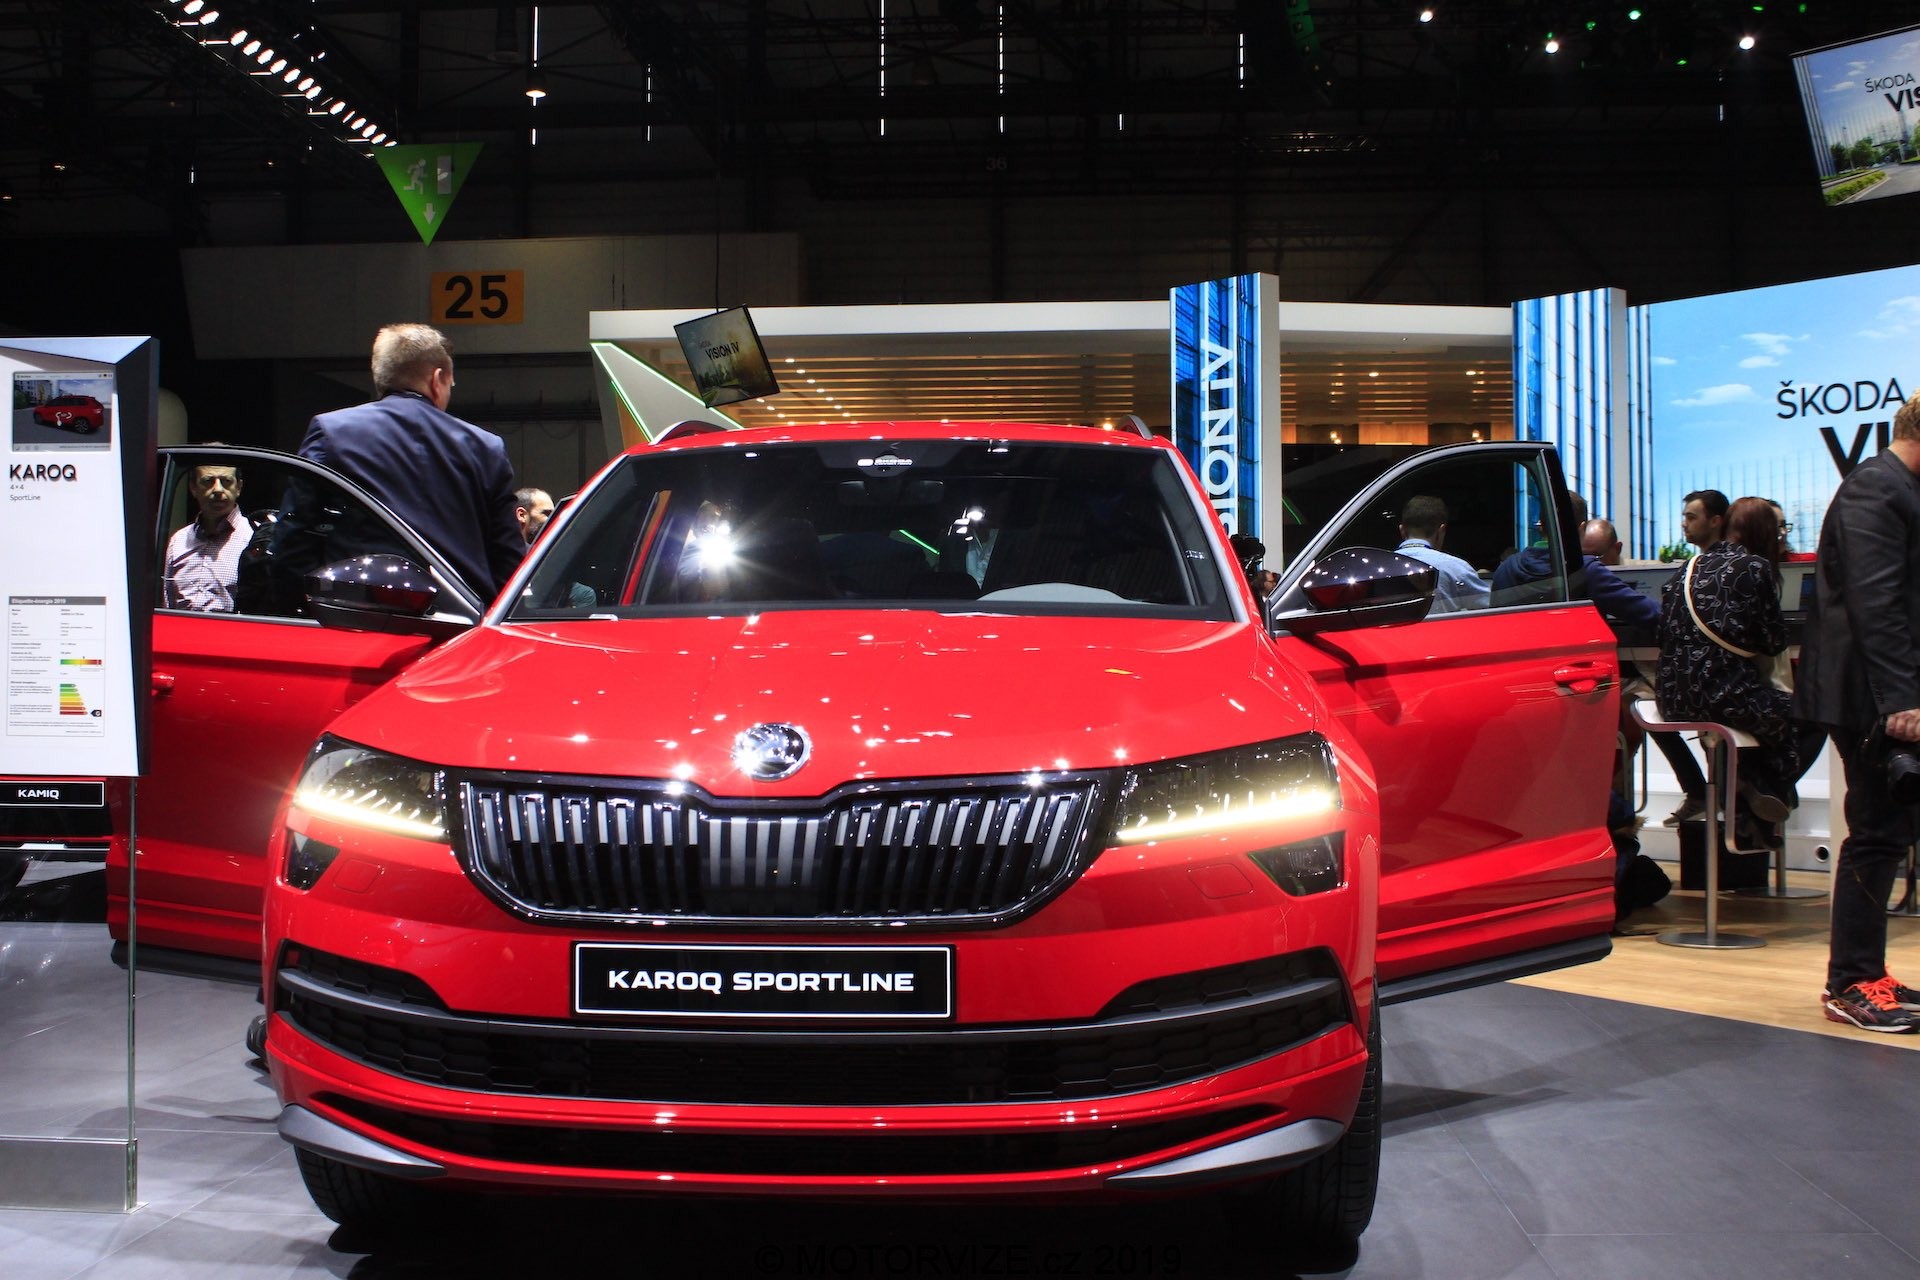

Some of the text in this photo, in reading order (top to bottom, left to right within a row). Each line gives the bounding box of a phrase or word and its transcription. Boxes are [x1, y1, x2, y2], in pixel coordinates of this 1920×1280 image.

[1865, 73, 1916, 93] ŠKODA
[1884, 87, 1920, 112] VIS
[445, 275, 509, 319] 25
[705, 344, 731, 360] VISION
[1777, 377, 1906, 419] ŠKODA
[9, 464, 77, 482] KAROQ
[9, 494, 41, 502] SportLine
[18, 789, 60, 799] KAMIQ
[608, 970, 915, 995] KAROQ SPORTLINE
